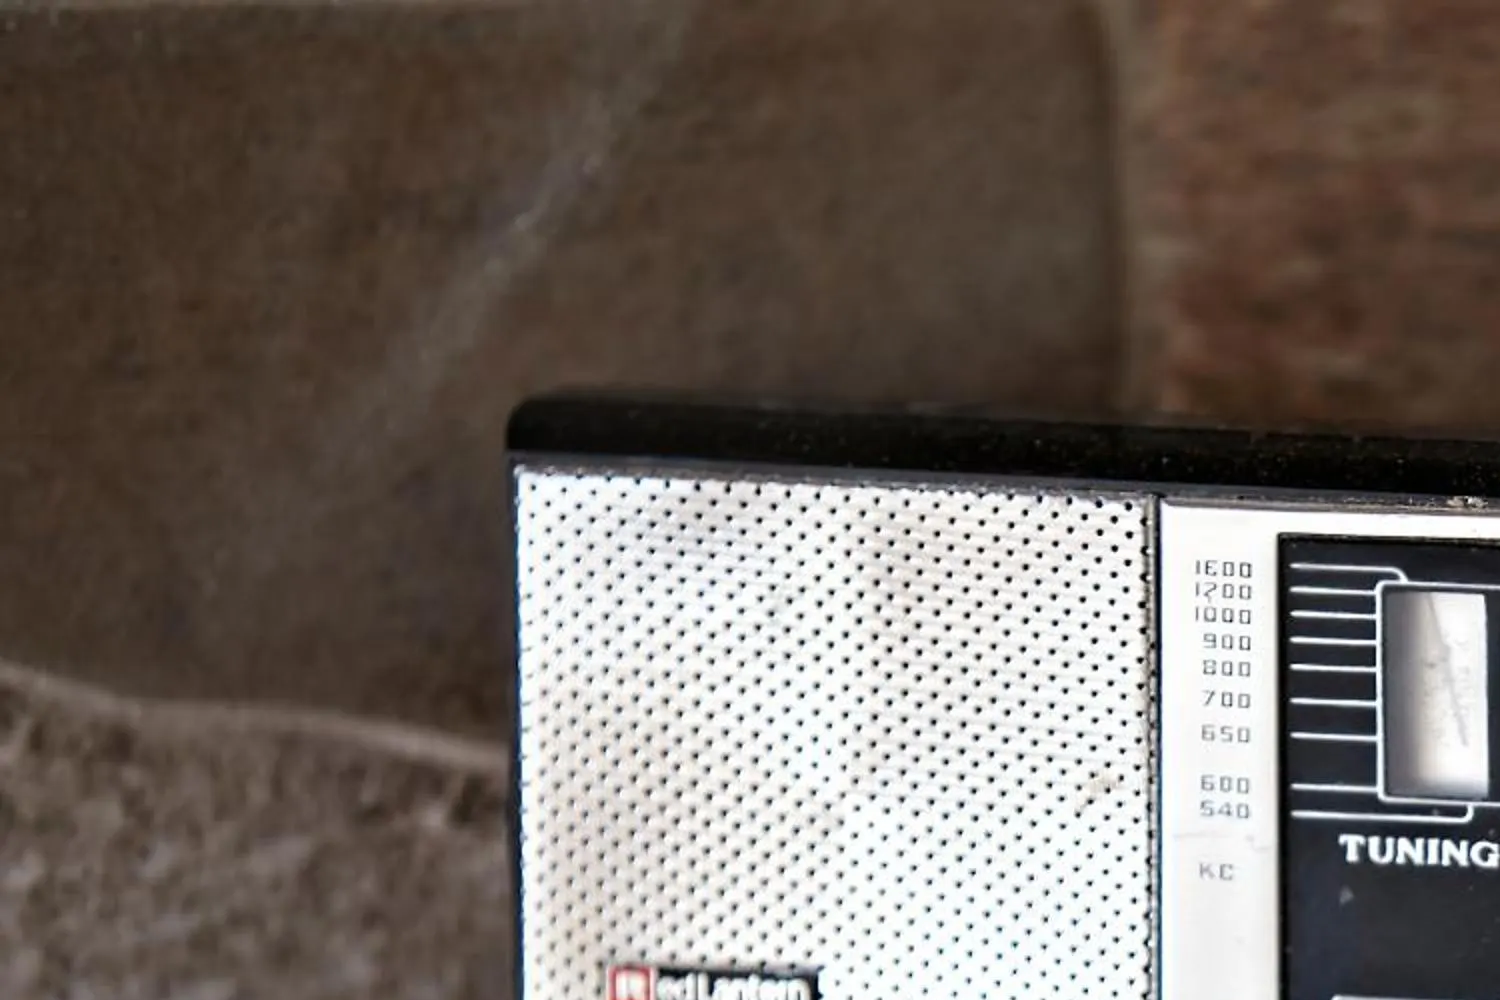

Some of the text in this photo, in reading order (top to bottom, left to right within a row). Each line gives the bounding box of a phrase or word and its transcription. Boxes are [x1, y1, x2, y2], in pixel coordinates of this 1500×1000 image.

[1195, 606, 1251, 625] 1000
[1203, 633, 1251, 651] 900
[1203, 659, 1251, 677] 800
[1202, 690, 1251, 709] 700
[1201, 724, 1251, 743] 650
[1200, 774, 1251, 794] 600
[1200, 800, 1251, 819] 540
[1338, 833, 1500, 868] TUNING
[1200, 863, 1234, 880] KC
